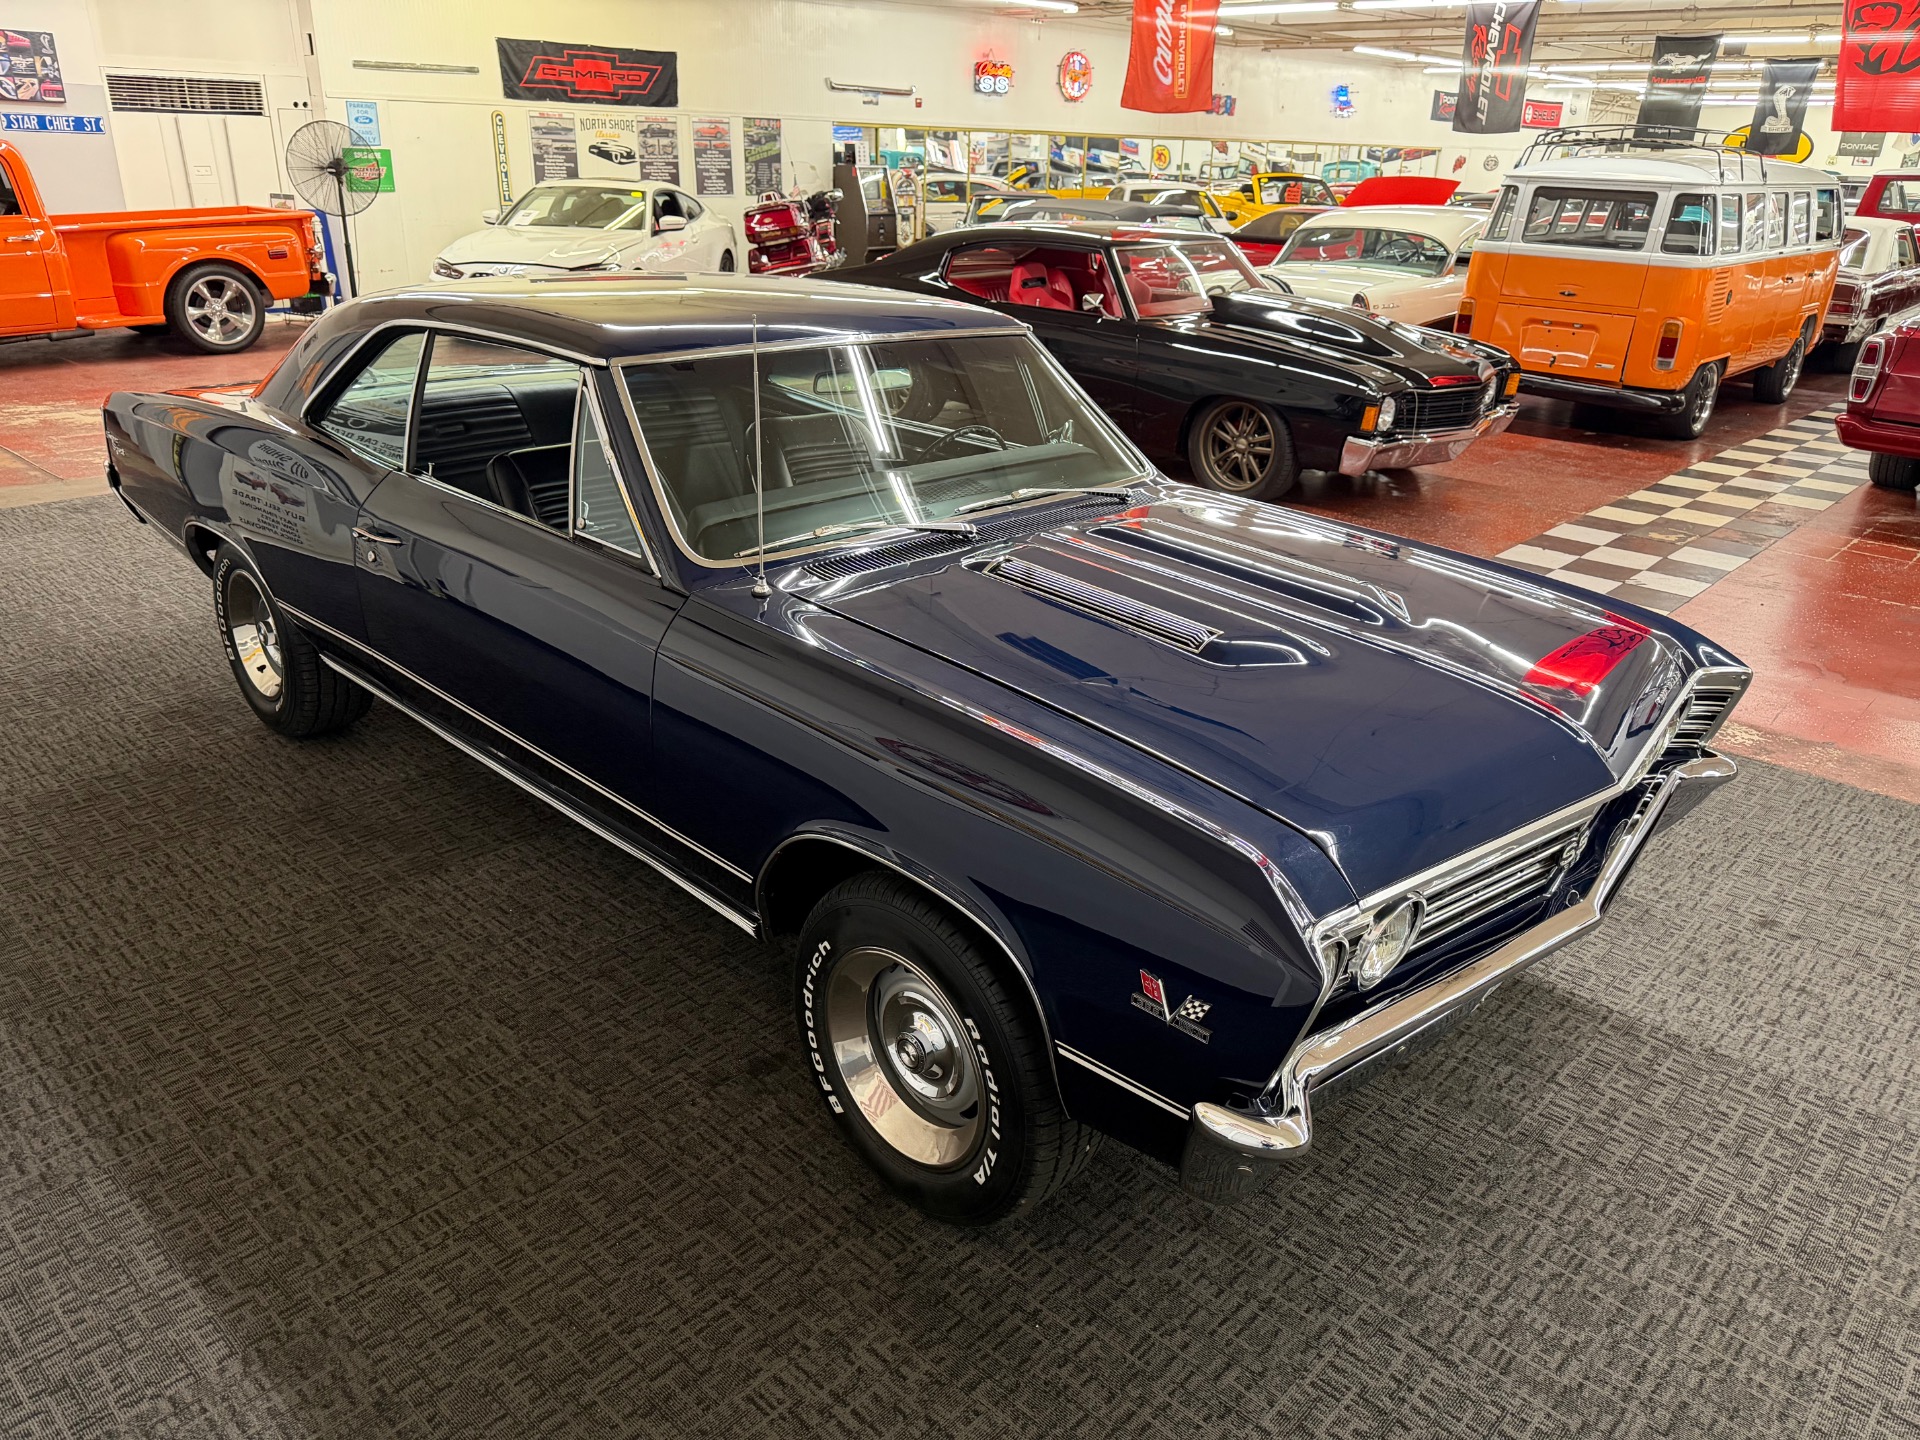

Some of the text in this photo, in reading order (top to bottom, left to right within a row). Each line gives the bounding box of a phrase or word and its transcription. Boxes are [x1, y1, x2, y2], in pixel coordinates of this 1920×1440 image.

[1177, 21, 1188, 92] CHEVROLET
[1476, 2, 1507, 126] CHEVROLET
[542, 67, 642, 82] CAMARO
[1651, 75, 1707, 85] MUSTANG
[979, 75, 1009, 93] SS
[348, 102, 375, 110] PARKING
[9, 114, 97, 132] STAR CHIEF ST
[1532, 109, 1560, 122] SHELBY
[579, 117, 607, 132] NORTH
[608, 118, 636, 133] SHORE
[594, 129, 621, 139] Classics
[1840, 142, 1880, 150] PONTIAC
[495, 115, 510, 201] CHEVROLET
[216, 557, 236, 662] BFGoodrich
[802, 940, 844, 1115] BFGoodrich
[964, 1018, 1001, 1186] Radial T/A
